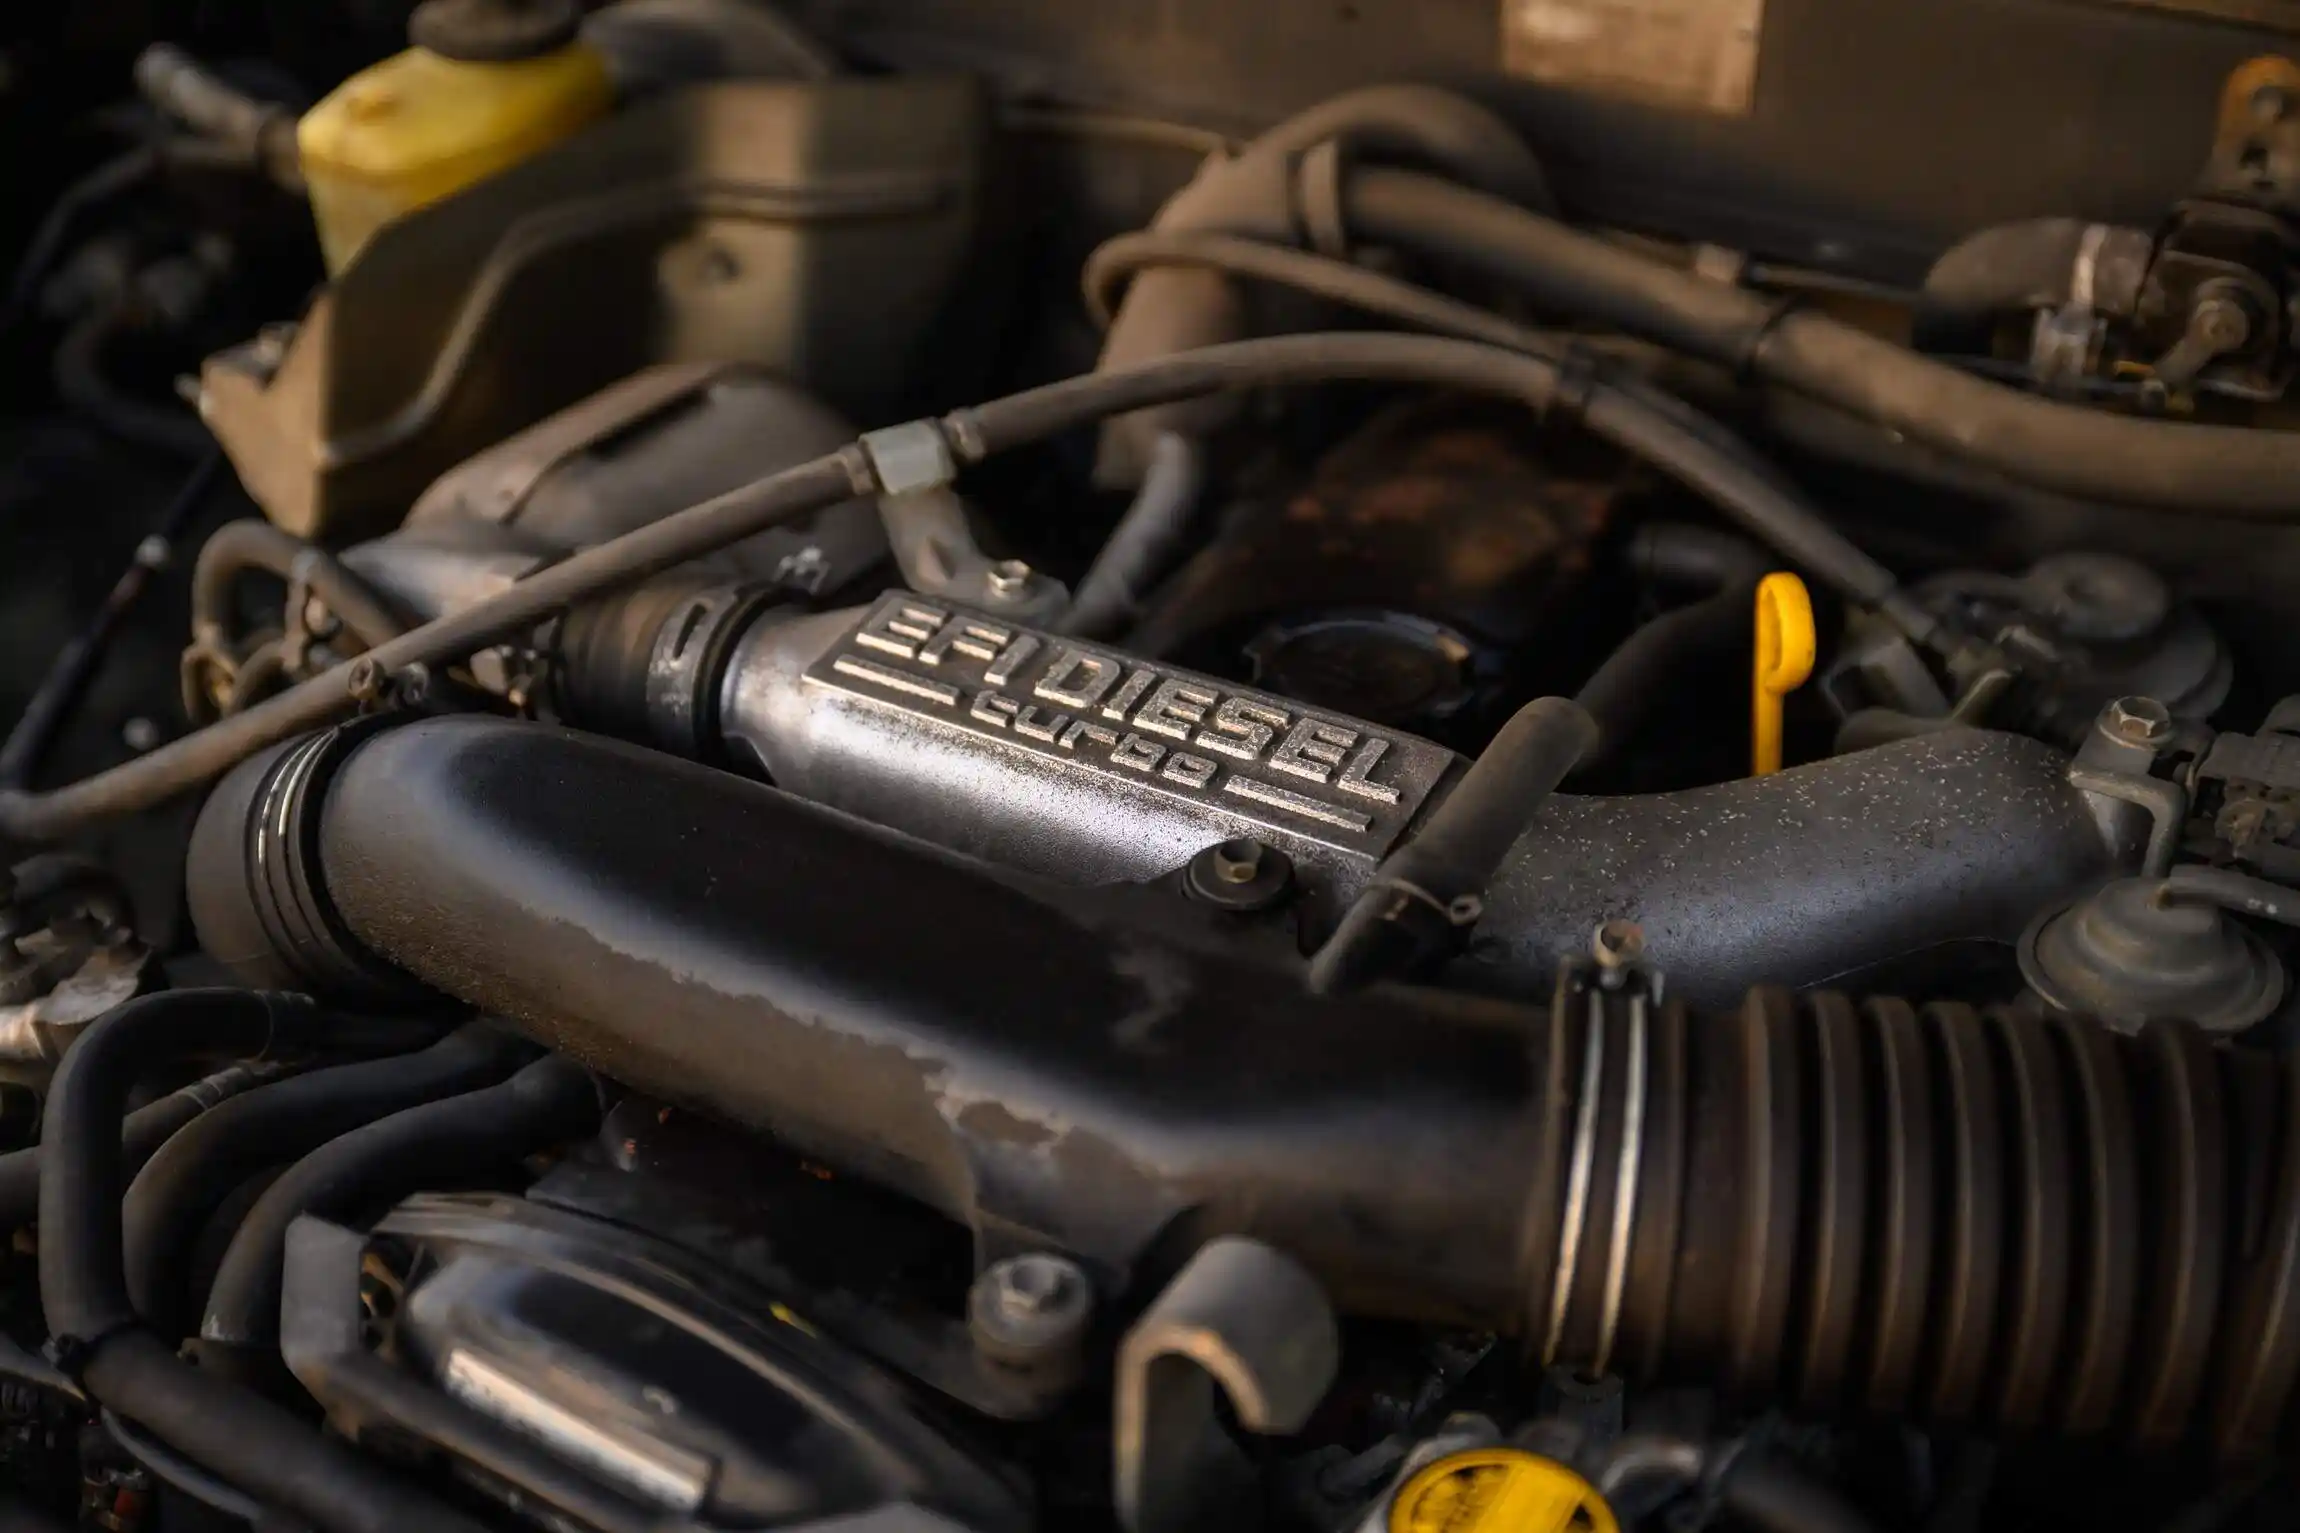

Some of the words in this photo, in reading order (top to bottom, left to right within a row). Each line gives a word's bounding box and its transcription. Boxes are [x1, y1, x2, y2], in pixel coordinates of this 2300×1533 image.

[855, 598, 1041, 687] EFI
[1033, 650, 1401, 805] DIESEL
[970, 689, 1218, 789] turbo
